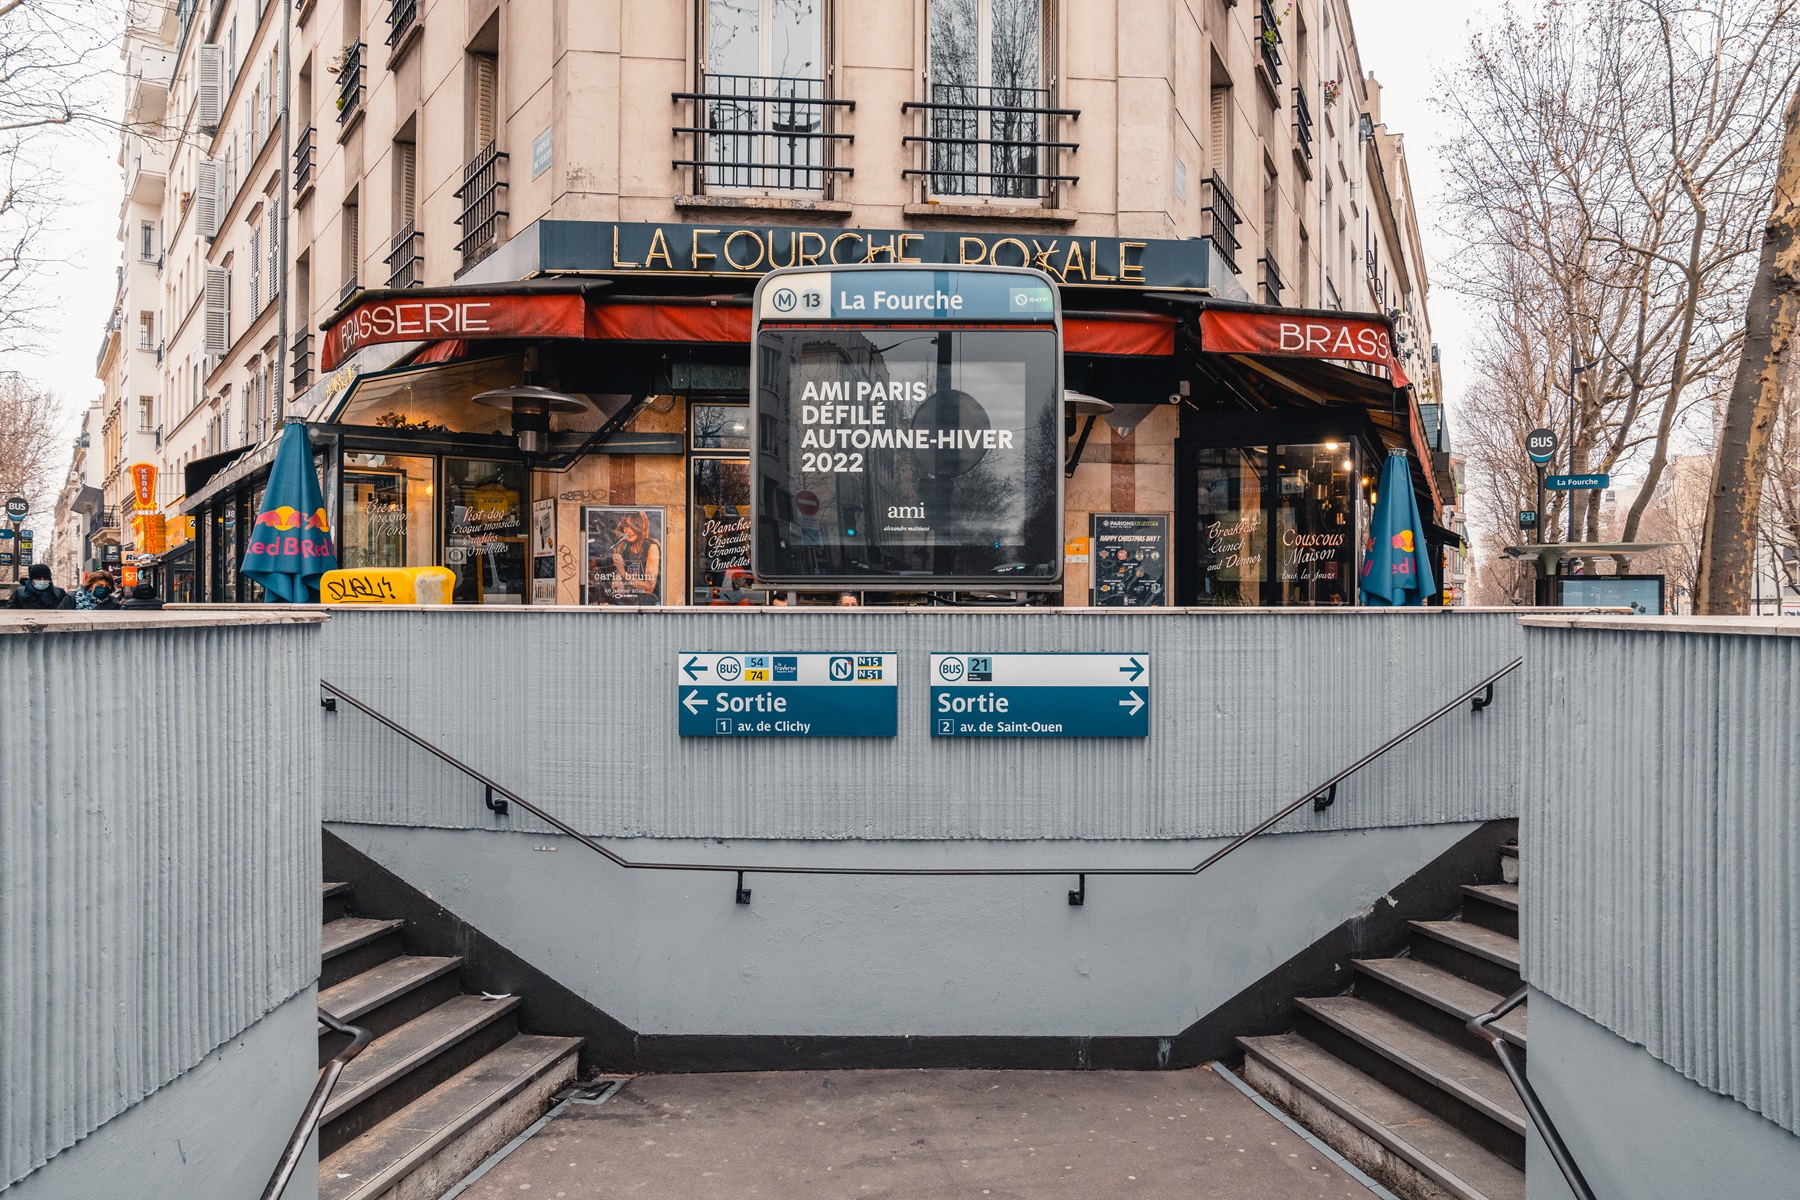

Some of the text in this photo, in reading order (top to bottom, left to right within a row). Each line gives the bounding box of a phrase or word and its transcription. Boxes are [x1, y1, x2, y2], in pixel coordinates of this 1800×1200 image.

[613, 225, 672, 269] LA
[802, 293, 821, 307] 13
[841, 291, 963, 310] La Fourche
[341, 302, 491, 353] BRASSERIE
[1279, 322, 1390, 359] BRASS
[801, 381, 927, 401] AMI PARIS
[802, 402, 886, 425] DÉFILÉ
[801, 429, 1013, 449] AUTOMNE-HIVER
[1530, 437, 1553, 448] BUS
[801, 452, 863, 472] 2022
[1568, 478, 1599, 486] Fourche
[8, 502, 26, 511] BUS
[887, 502, 926, 519] ami
[1208, 521, 1261, 539] Breakfast
[1282, 528, 1345, 547] Couscous
[711, 556, 750, 571] Omelettes
[1207, 554, 1261, 571] and Dinner
[1284, 547, 1336, 566] Maison
[594, 571, 655, 580] carla bruni
[1300, 568, 1311, 580] les
[1311, 569, 1335, 582] jours
[720, 658, 764, 674] BUS 54
[859, 657, 879, 666] N15
[942, 658, 988, 674] BUS 21
[750, 670, 764, 680] 74
[859, 670, 879, 679] N51
[716, 692, 787, 712] Sortie
[938, 692, 1009, 713] Sortie
[737, 722, 754, 732] av.
[756, 721, 771, 731] de
[774, 721, 811, 733] Clichy
[960, 723, 977, 732] av.
[979, 721, 994, 732] de
[997, 721, 1063, 732] Saint-Ouen
